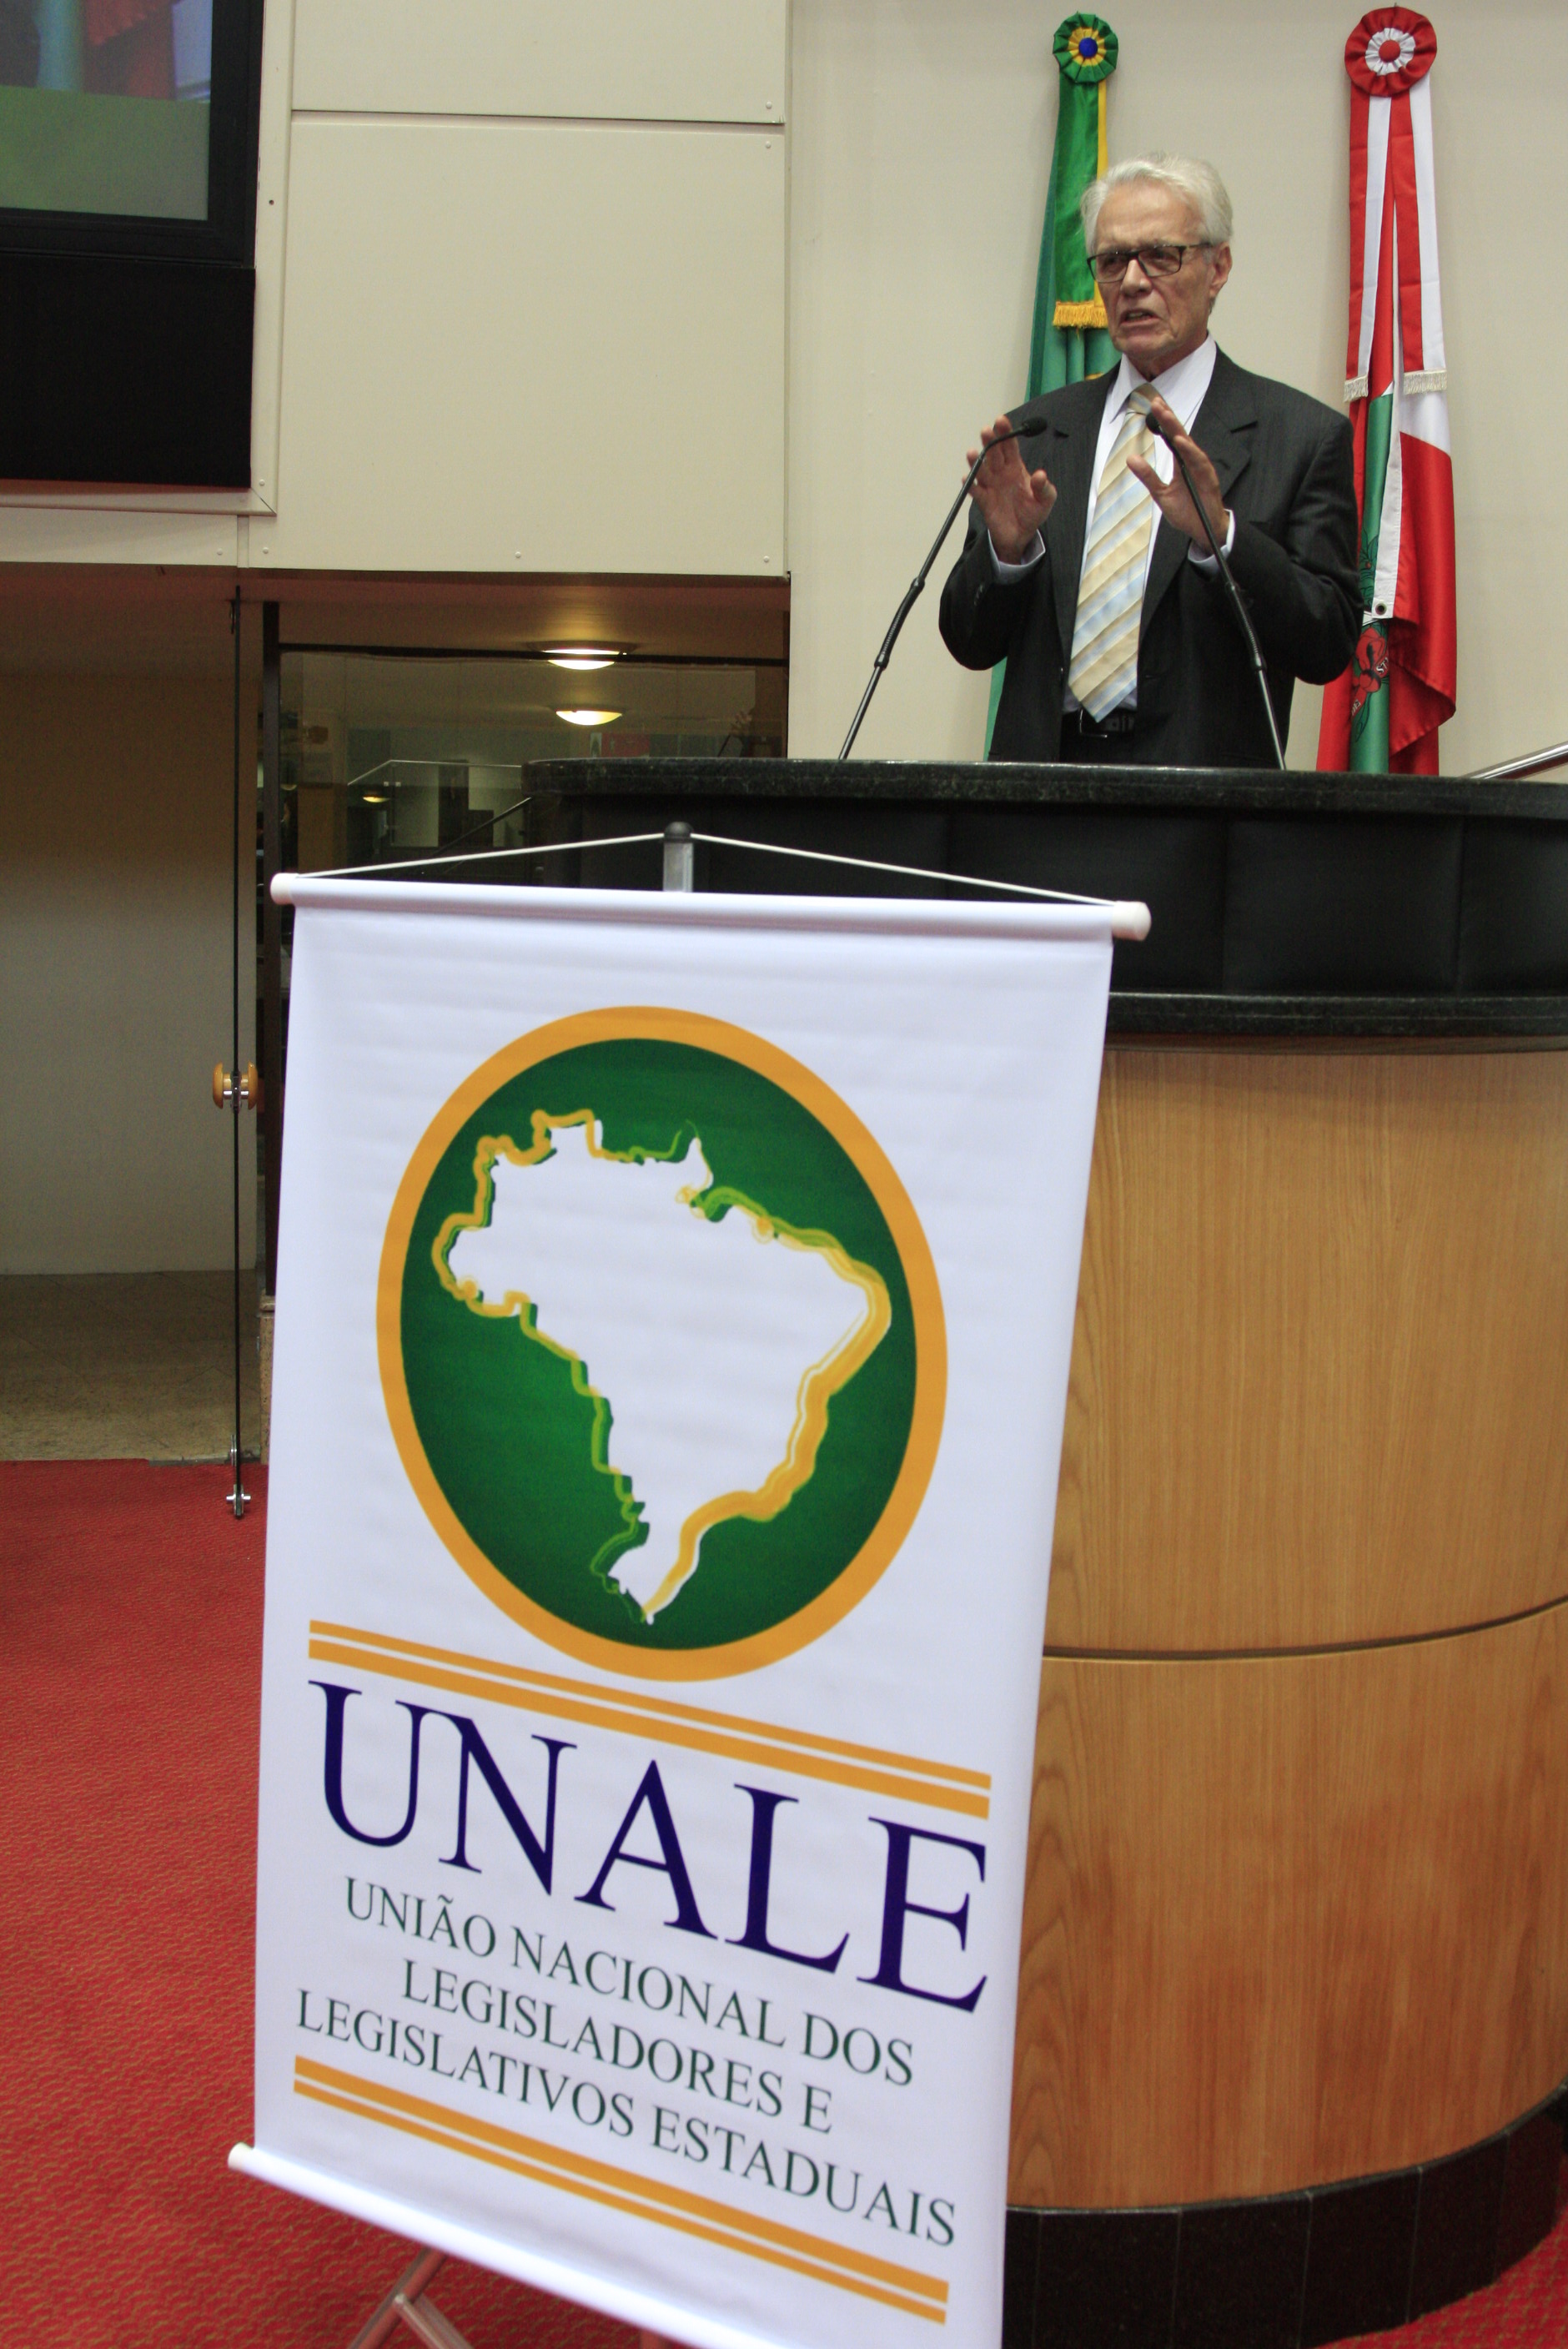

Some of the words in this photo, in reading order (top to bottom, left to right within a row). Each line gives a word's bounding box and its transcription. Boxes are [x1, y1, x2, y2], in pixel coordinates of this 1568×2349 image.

[309, 1680, 988, 2014] UNALE
[346, 1877, 496, 1959] UNIÃO
[511, 1925, 786, 2049] NACIONAL
[801, 2011, 913, 2087] DOS
[402, 1959, 784, 2118] LEGISLADORES
[802, 2084, 833, 2135] E
[296, 1989, 636, 2138] LEGISLATIVOS
[651, 2105, 957, 2247] ESTADUAIS
